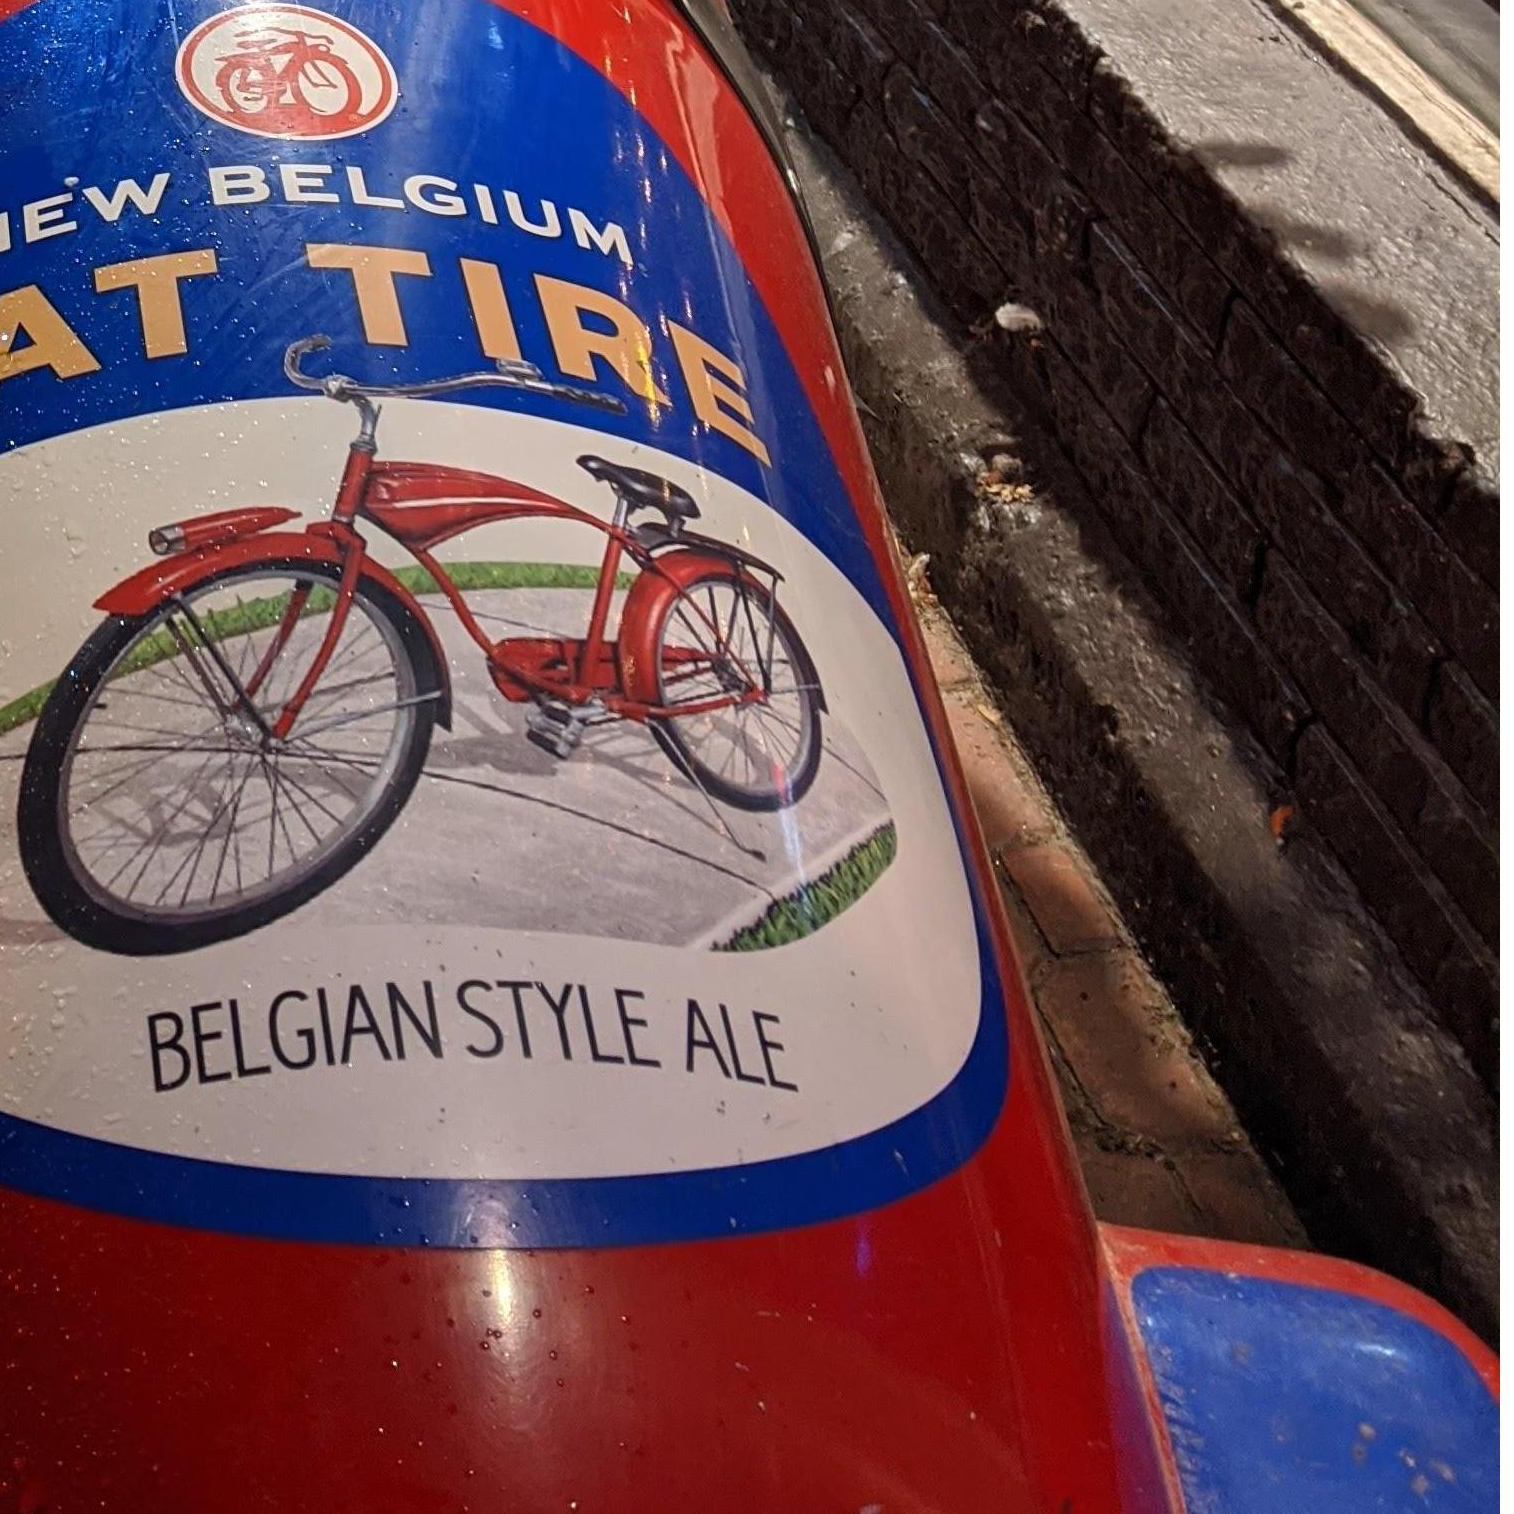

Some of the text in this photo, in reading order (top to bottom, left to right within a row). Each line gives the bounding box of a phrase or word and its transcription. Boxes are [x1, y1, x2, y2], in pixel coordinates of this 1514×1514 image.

[211, 163, 635, 266] BELGIUM
[304, 242, 773, 469] TIRE
[146, 979, 799, 1093] BELGIAN STYLE ALE
